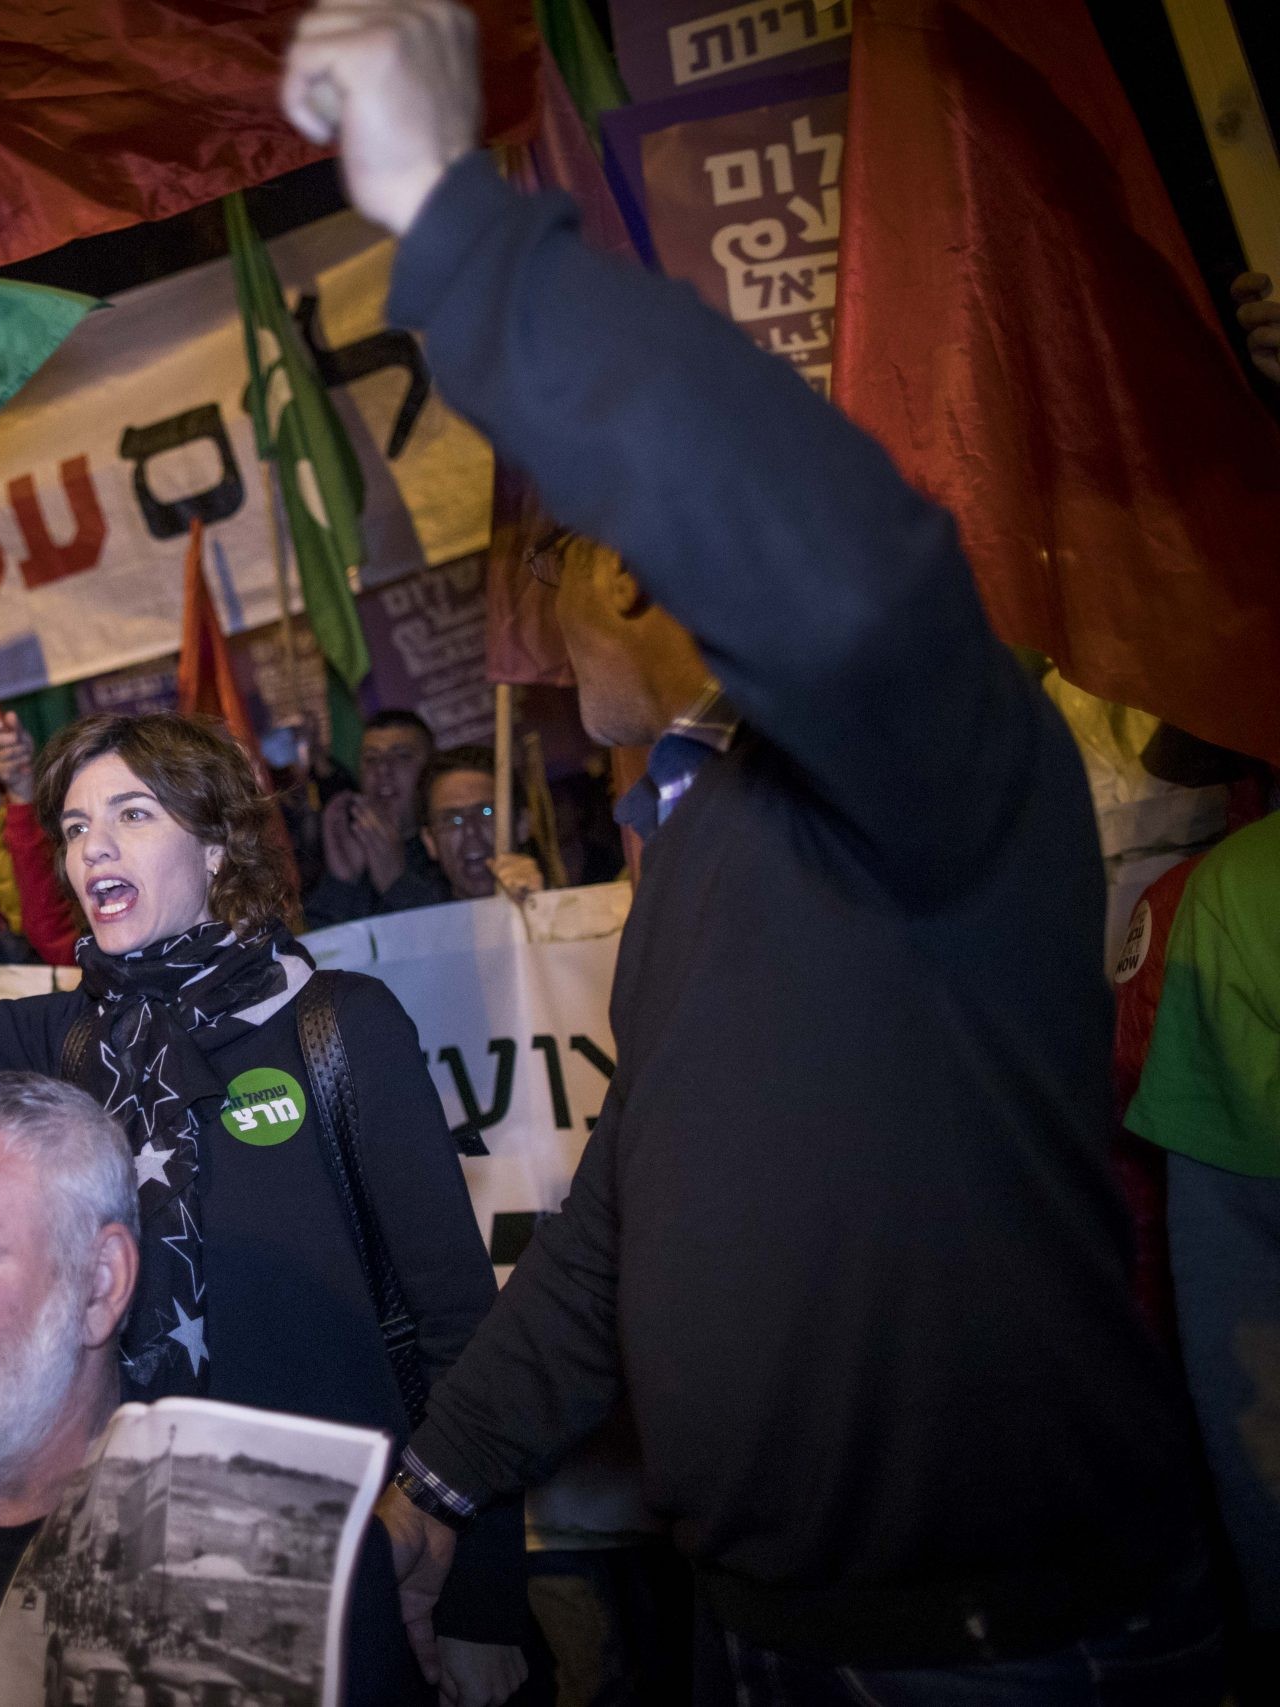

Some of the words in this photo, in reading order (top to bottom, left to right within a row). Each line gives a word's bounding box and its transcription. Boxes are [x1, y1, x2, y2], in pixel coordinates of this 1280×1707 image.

[703, 115, 844, 207] לום
[242, 1084, 288, 1105] שמאל
[231, 1097, 300, 1132] מרצ
